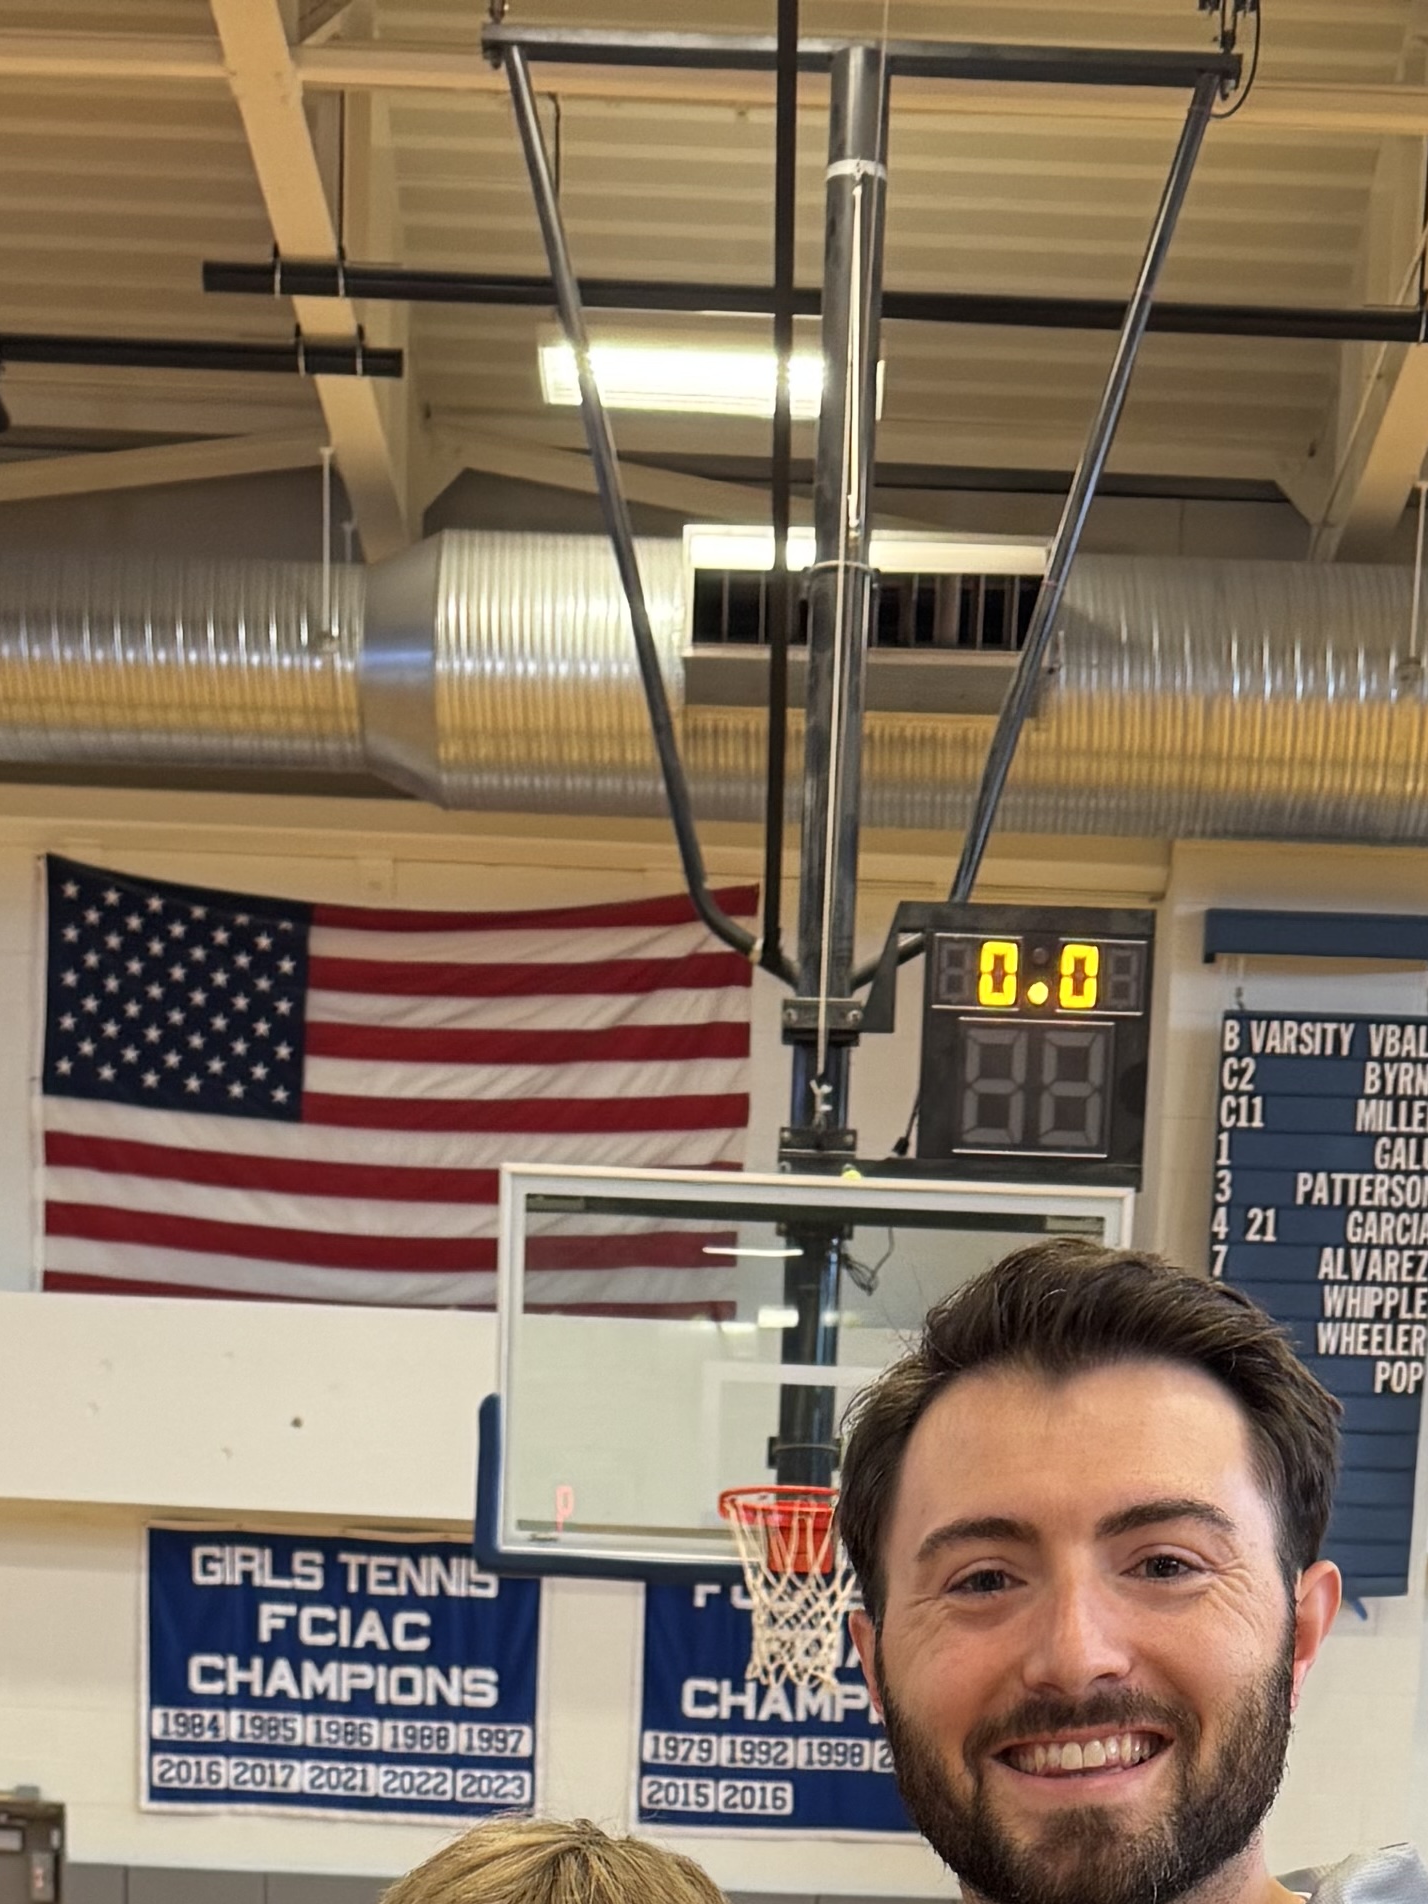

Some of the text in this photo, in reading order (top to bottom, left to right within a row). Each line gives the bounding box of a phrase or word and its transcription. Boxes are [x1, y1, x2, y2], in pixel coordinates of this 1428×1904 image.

[978, 940, 1099, 1009] 0.0
[1224, 1019, 1240, 1052] B
[1250, 1020, 1355, 1056] VARSITY
[1222, 1057, 1256, 1091] C2
[1220, 1095, 1264, 1128] C11
[1216, 1131, 1230, 1166] 1
[1215, 1169, 1232, 1203] 3
[1211, 1207, 1229, 1240] 4
[1245, 1207, 1276, 1242] 21
[1212, 1245, 1228, 1277] 7
[1323, 1285, 1428, 1320] WHIPPLE
[1317, 1322, 1427, 1356] WHEELER
[1374, 1361, 1423, 1394] POP
[192, 1545, 499, 1599] GIRLS TENNIS
[258, 1603, 431, 1652] FCIAC
[188, 1654, 499, 1708] CHAMPIONS
[161, 1712, 220, 1738] 1984
[237, 1714, 298, 1742] 1985
[314, 1719, 374, 1746] 1986
[464, 1727, 524, 1754] 1997
[652, 1734, 712, 1762] 1979
[728, 1740, 788, 1766] 1992
[804, 1741, 864, 1768] 1998
[157, 1759, 525, 1800] 2016 2017 2021 2022 2023
[646, 1780, 786, 1810] 2015 2016
